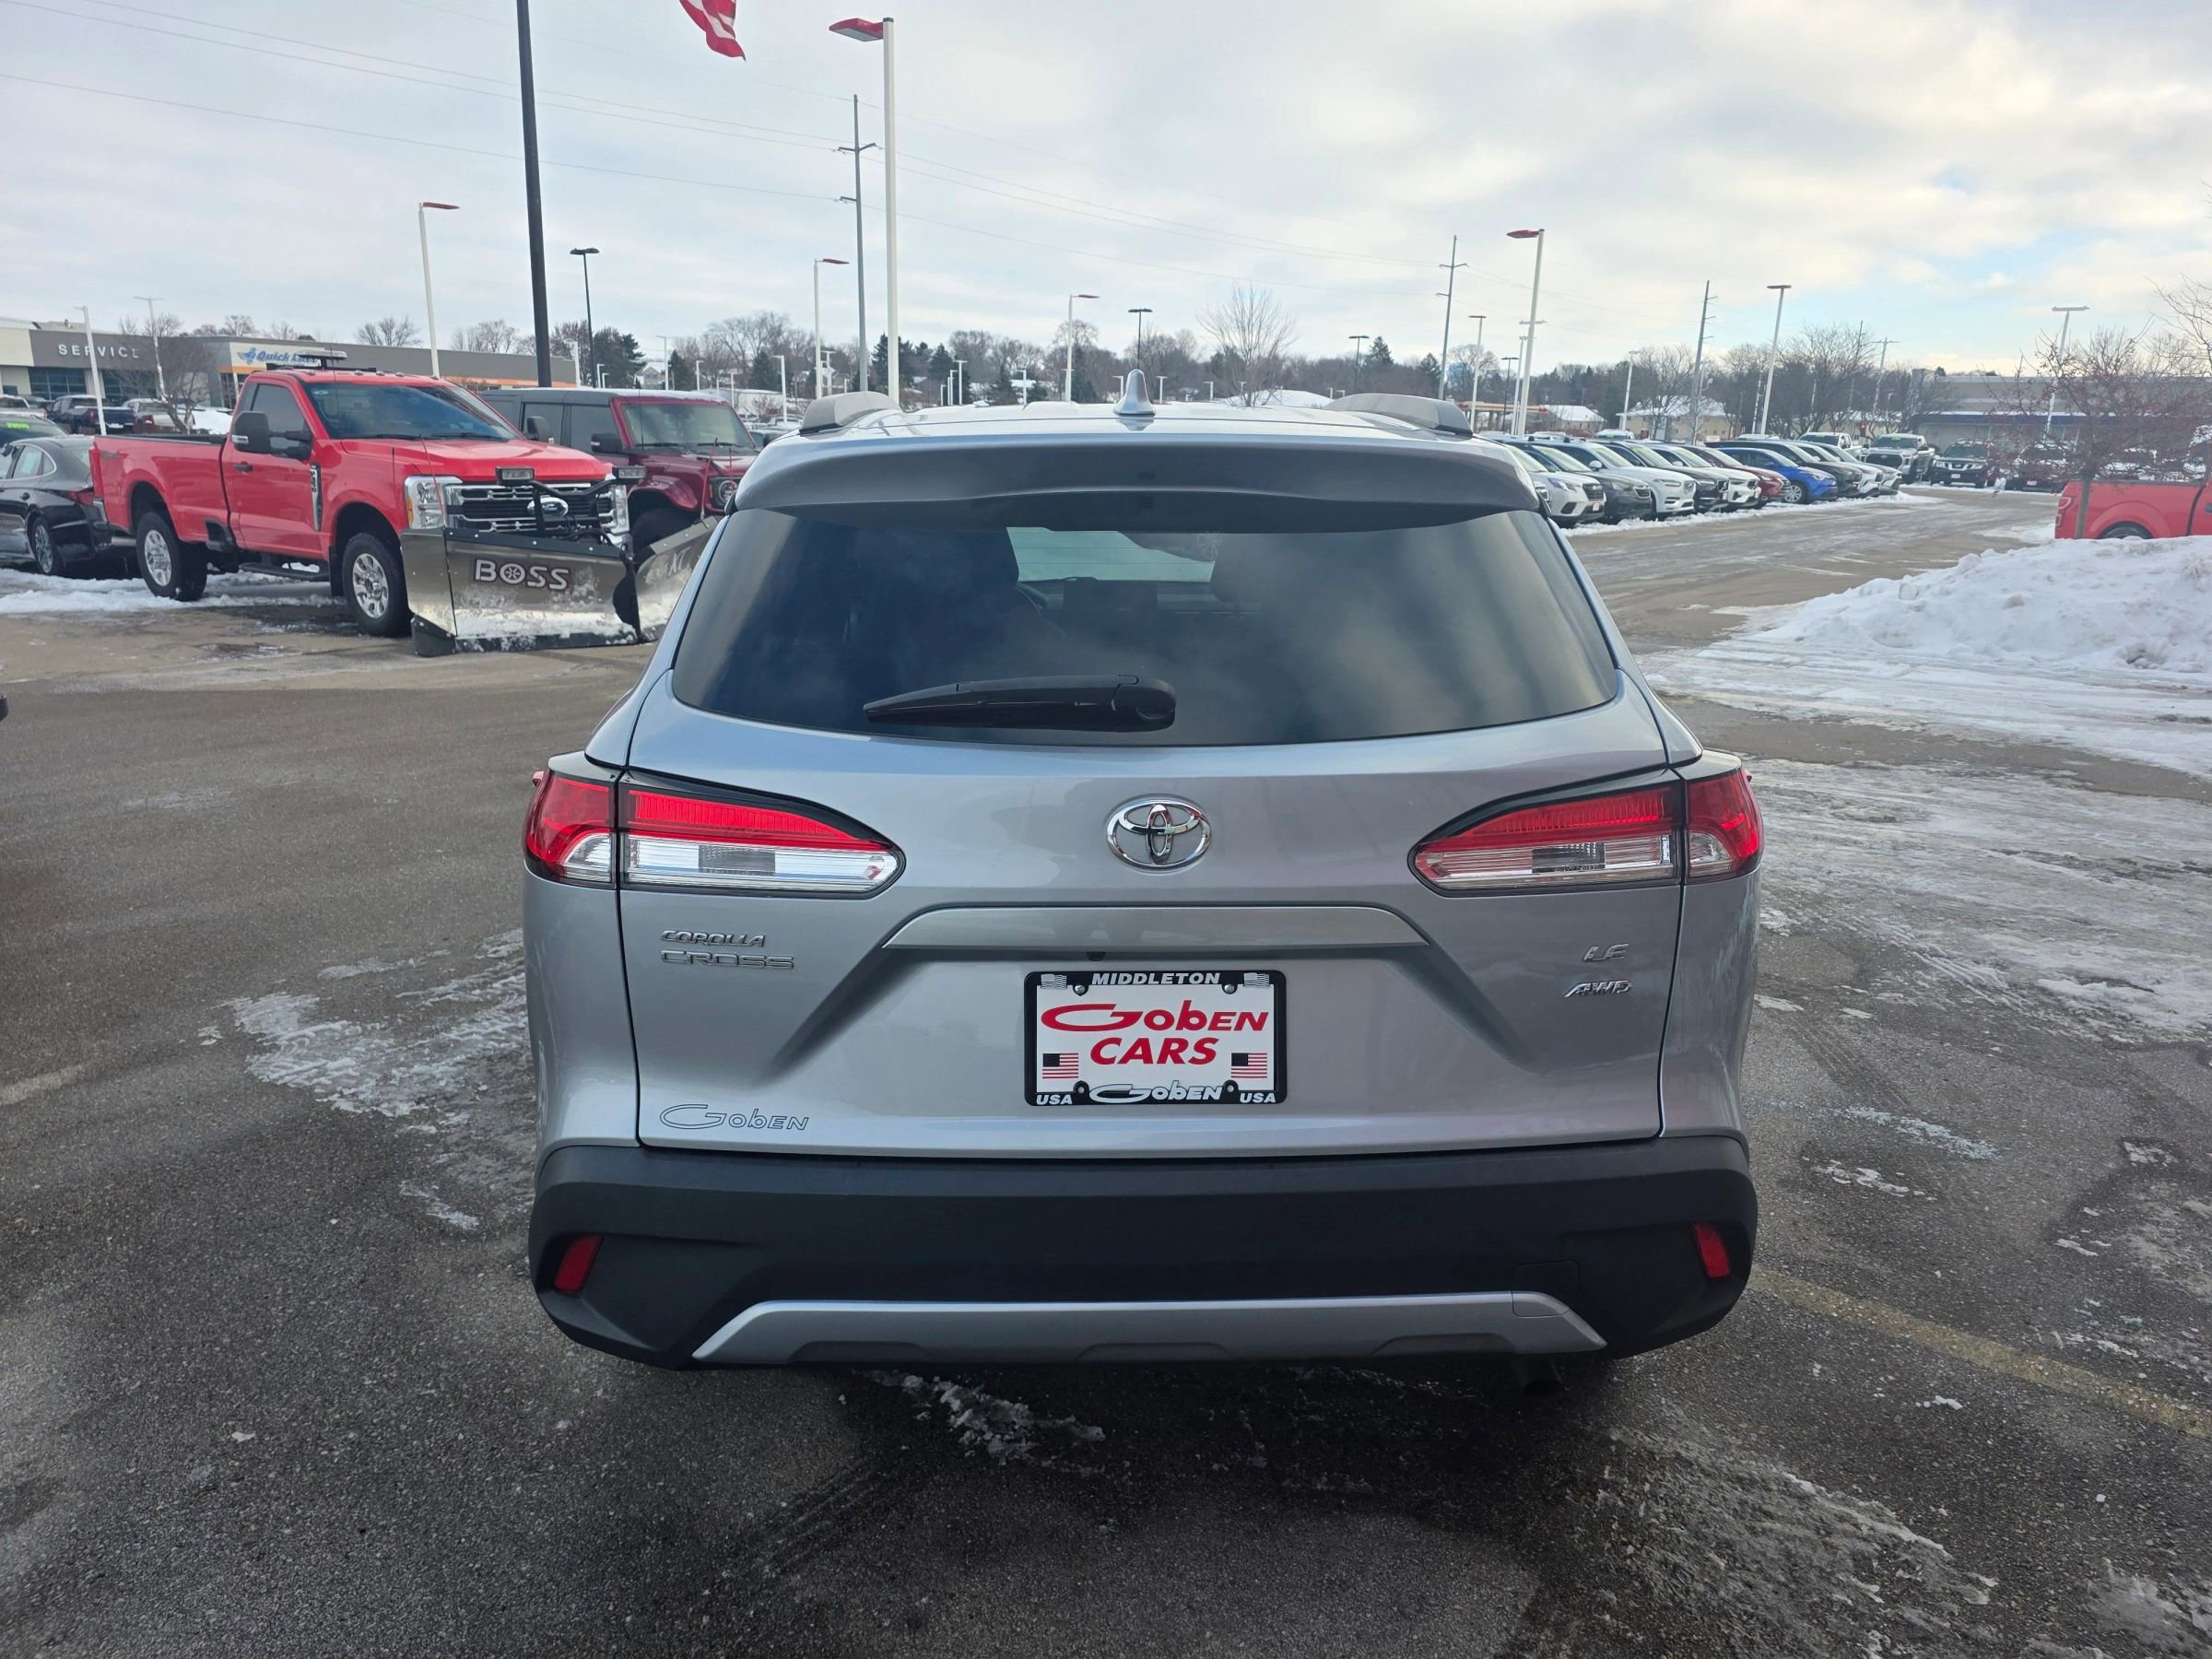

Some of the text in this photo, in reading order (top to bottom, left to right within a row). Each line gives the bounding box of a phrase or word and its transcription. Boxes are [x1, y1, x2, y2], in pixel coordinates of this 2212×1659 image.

[256, 350, 289, 362] Quick
[474, 558, 571, 592] BOSS
[660, 929, 766, 947] COROLLA
[660, 949, 794, 970] CROSS
[1583, 943, 1630, 962] LE
[1091, 972, 1221, 986] MIDDLETON
[1563, 980, 1633, 998] AWD
[1089, 1037, 1220, 1065] CARS
[1035, 1093, 1074, 1106] USA
[1240, 1092, 1277, 1104] USA
